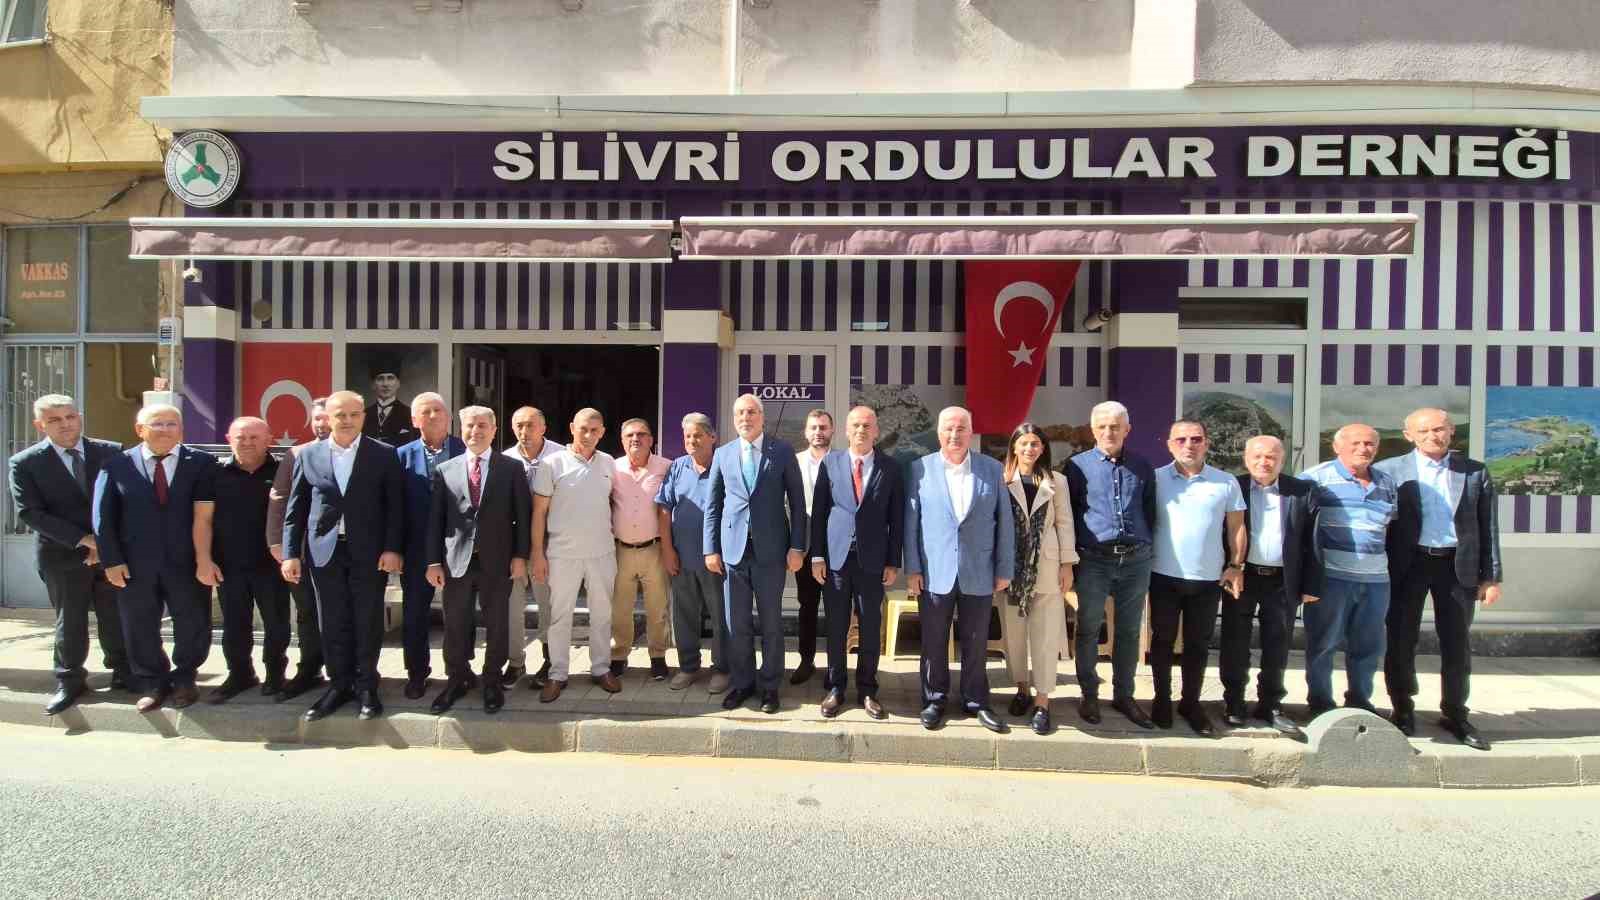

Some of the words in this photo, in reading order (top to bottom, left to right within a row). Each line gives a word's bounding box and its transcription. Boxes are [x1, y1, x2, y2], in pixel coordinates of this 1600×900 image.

[493, 132, 740, 182] SİLİVRİ
[771, 136, 1217, 182] ORDULULAR
[1247, 127, 1571, 182] DERNEĞİ
[21, 263, 68, 280] VAKKAS
[752, 386, 811, 399] LOKAL
